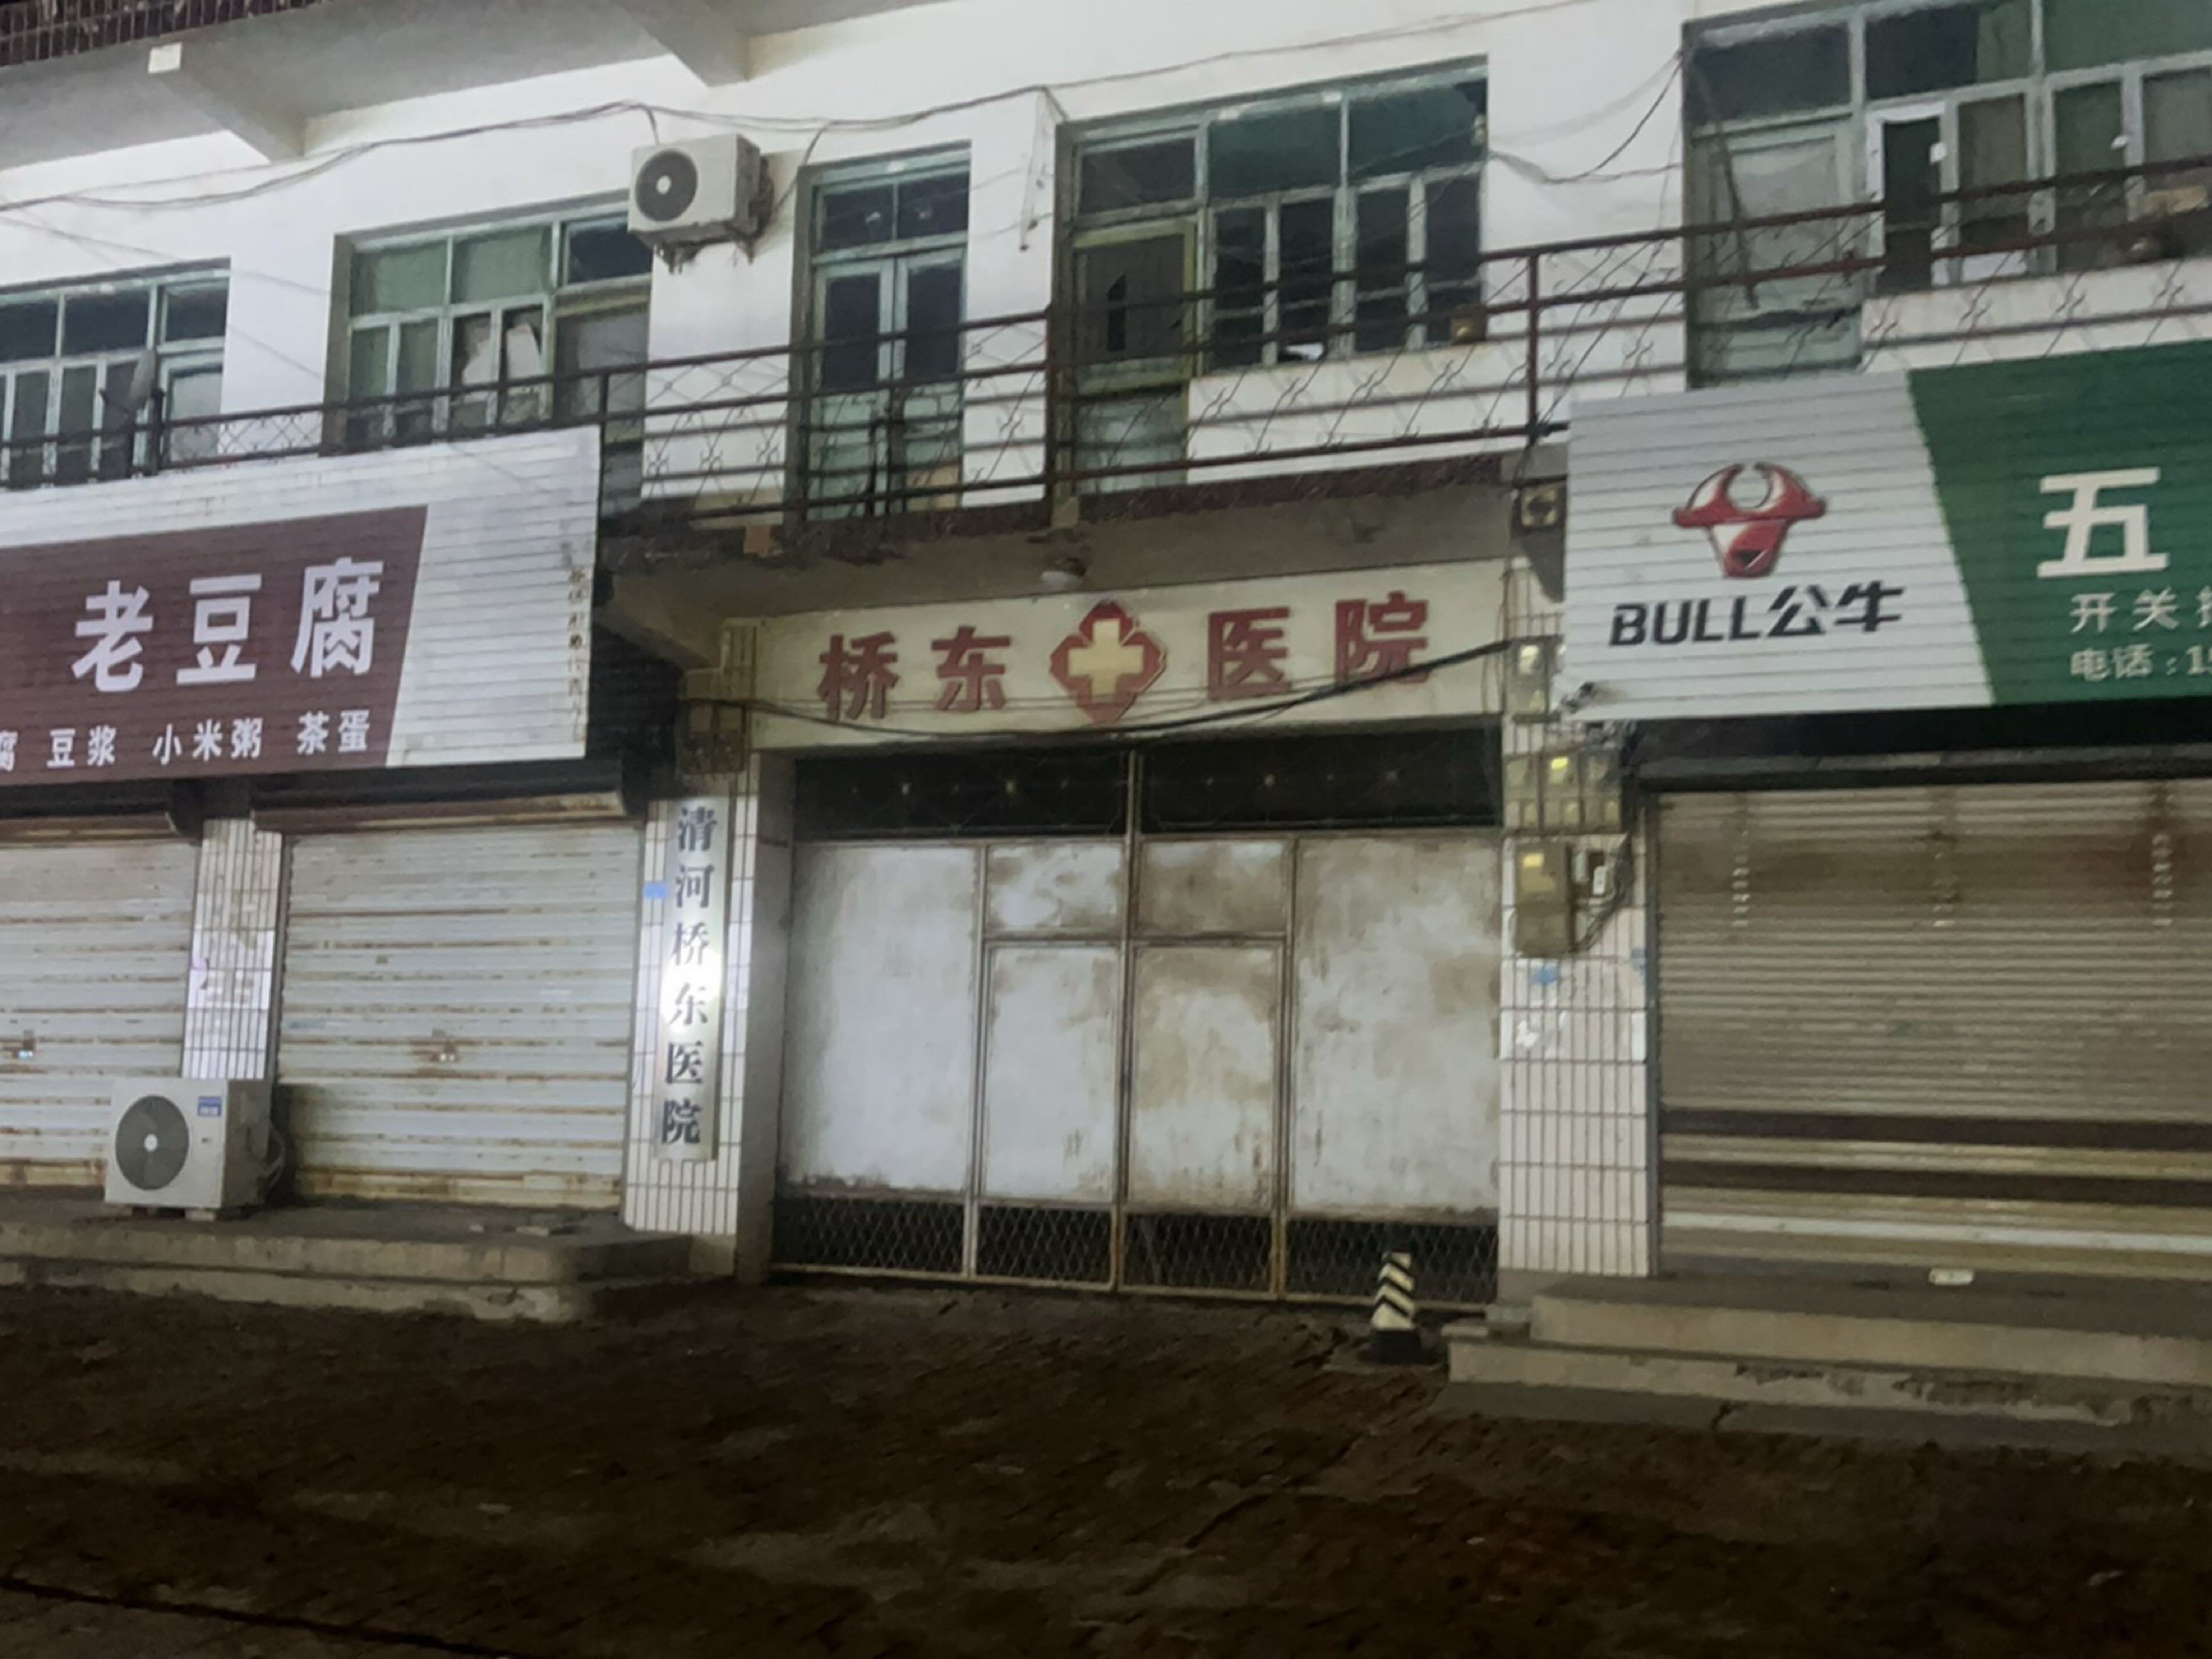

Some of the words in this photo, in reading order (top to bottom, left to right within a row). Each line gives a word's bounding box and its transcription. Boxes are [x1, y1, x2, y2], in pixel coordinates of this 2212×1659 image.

[2036, 467, 2169, 578] 五
[72, 556, 385, 693] 老豆腐
[818, 625, 1011, 722] 桥东
[1206, 591, 1430, 702] 医院
[2070, 644, 2212, 682] 电话:1
[46, 723, 117, 769] 豆浆
[152, 717, 263, 766] 小米粥
[296, 709, 371, 757] 茶蛋
[661, 805, 719, 1146] 清河桥东医院
